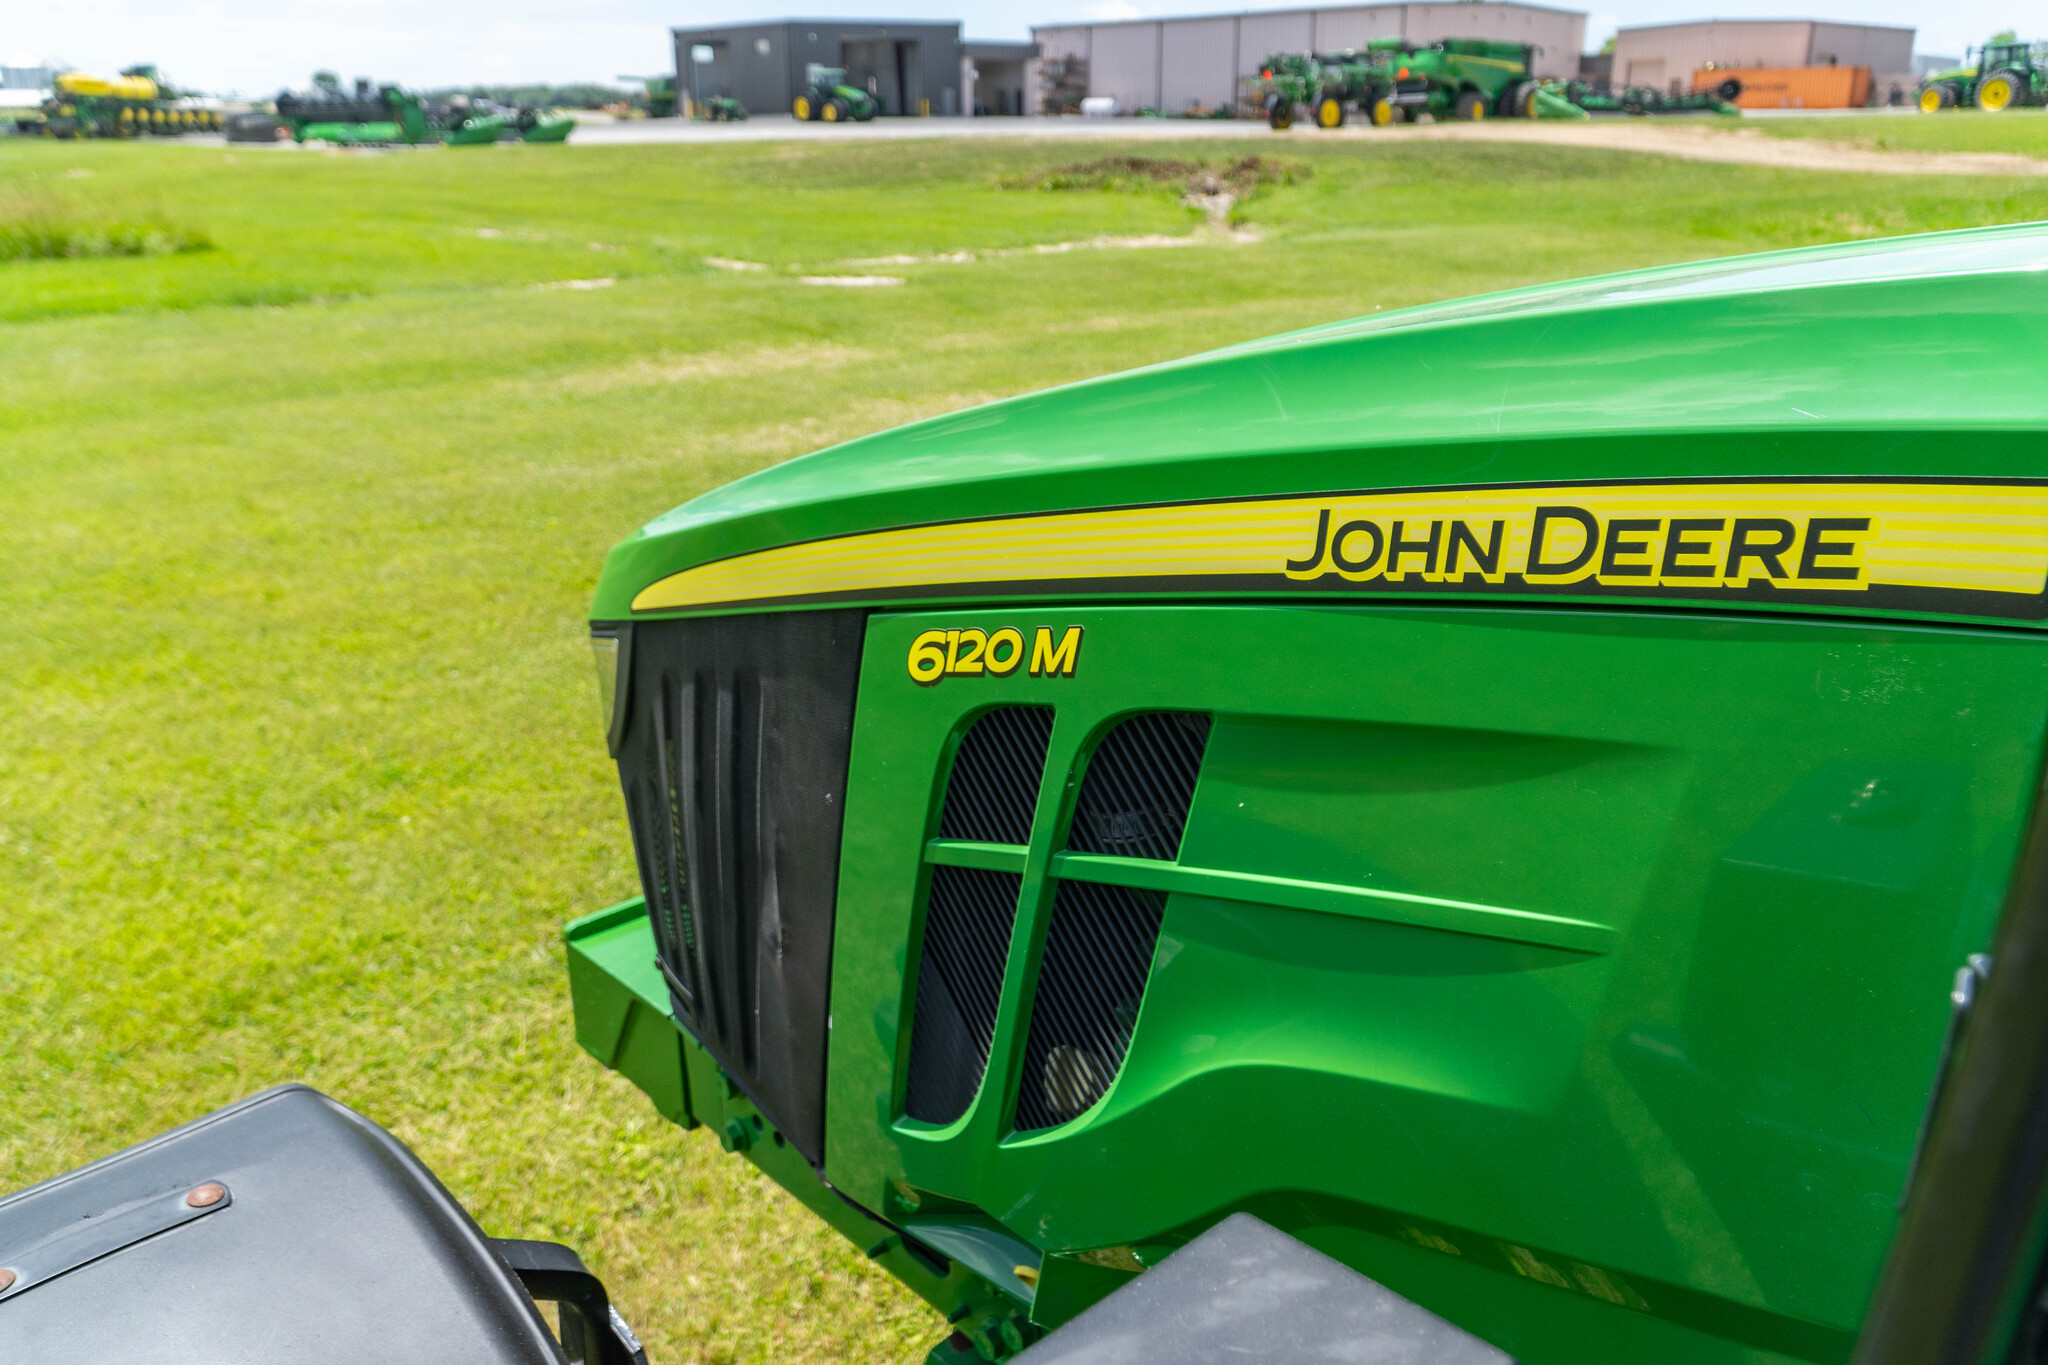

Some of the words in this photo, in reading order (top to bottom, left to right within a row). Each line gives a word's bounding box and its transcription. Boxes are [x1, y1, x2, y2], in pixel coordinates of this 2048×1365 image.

[1285, 507, 1508, 579] JOHN
[1525, 505, 1872, 581] DEERE
[907, 628, 1024, 685] 6120
[1029, 626, 1084, 677] M
